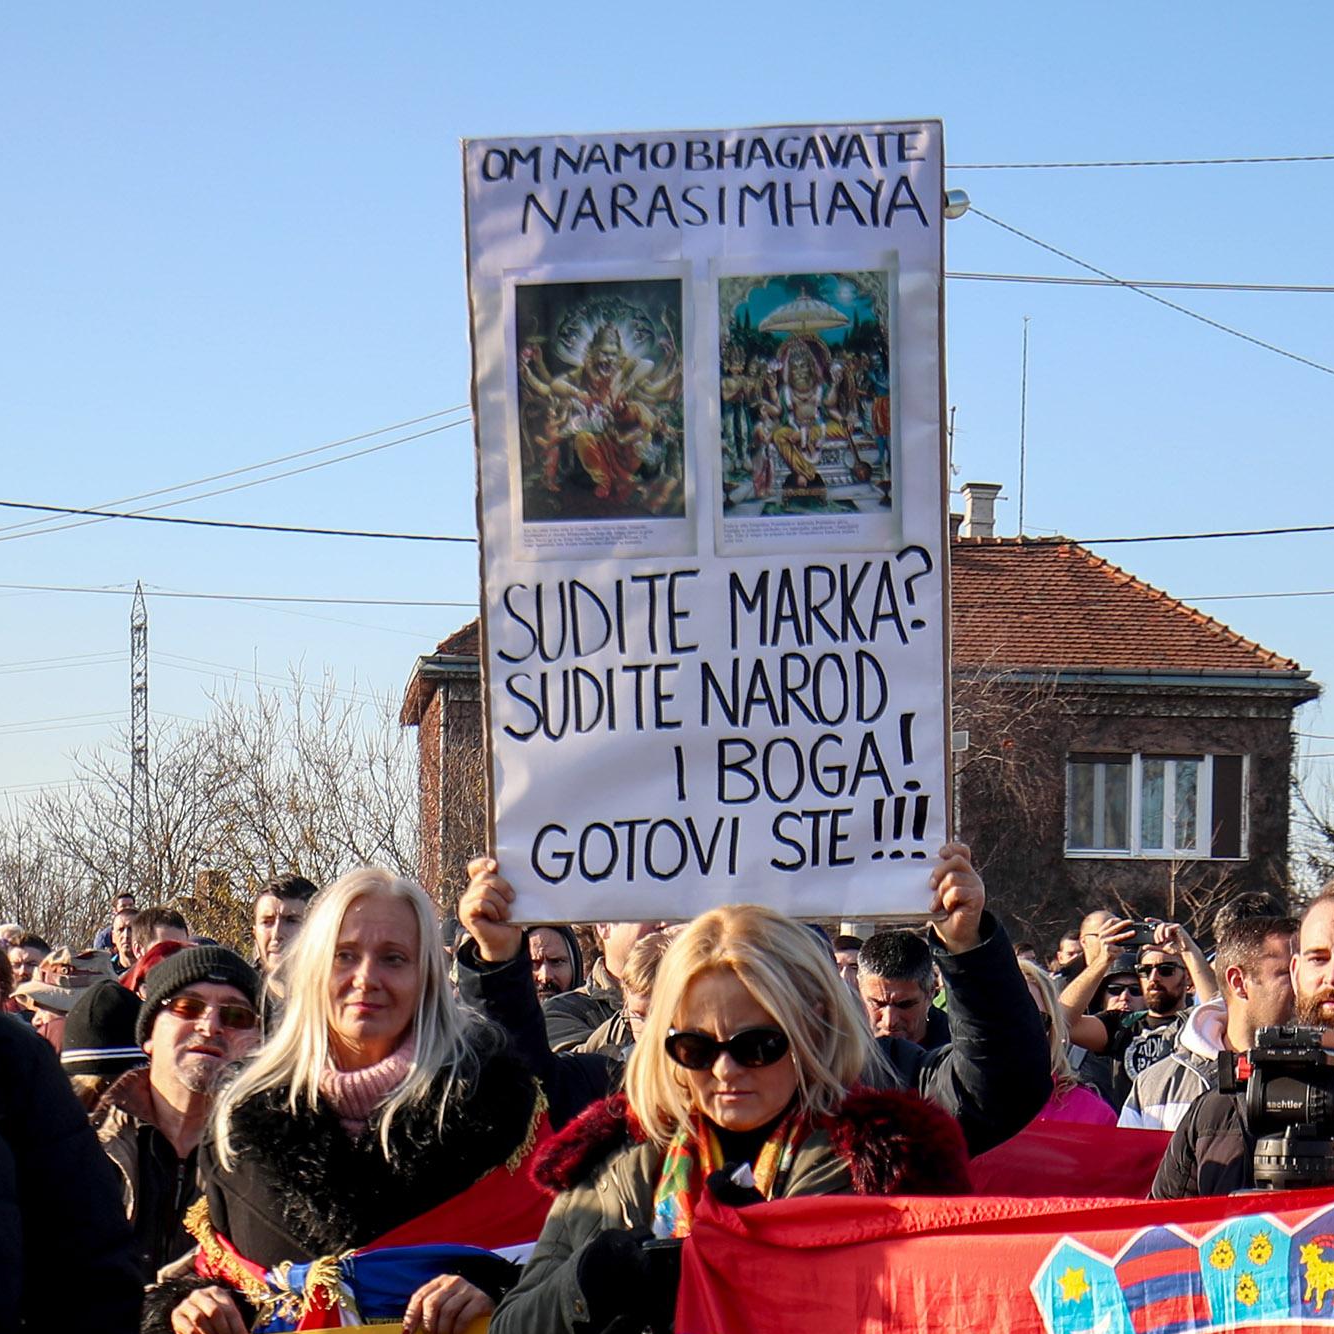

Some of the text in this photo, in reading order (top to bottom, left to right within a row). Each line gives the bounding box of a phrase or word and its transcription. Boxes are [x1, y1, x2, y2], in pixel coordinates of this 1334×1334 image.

[482, 145, 542, 183] OM
[522, 175, 929, 234] NARASIMHAYA
[497, 545, 934, 663] SUDITE MARKA?
[504, 649, 888, 742] SUDITE NAROD
[673, 711, 922, 805] I BOGA!
[531, 816, 740, 885] GOTOVI
